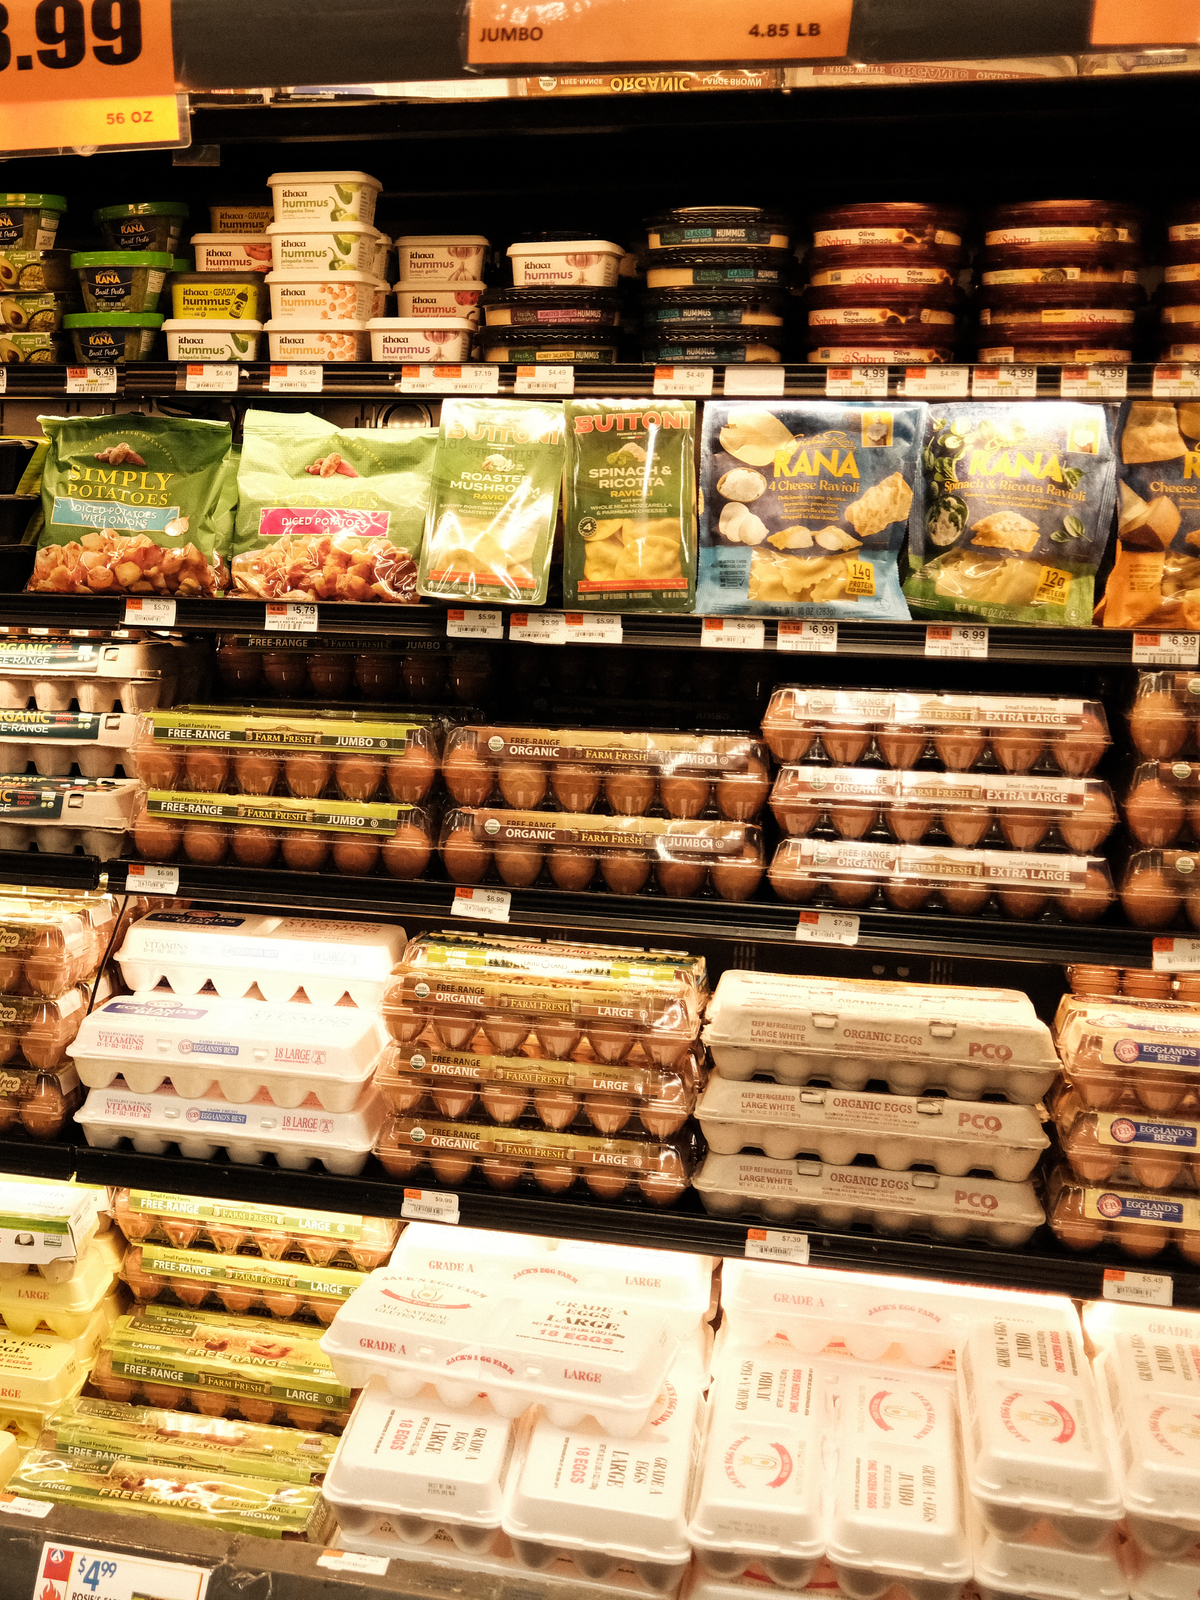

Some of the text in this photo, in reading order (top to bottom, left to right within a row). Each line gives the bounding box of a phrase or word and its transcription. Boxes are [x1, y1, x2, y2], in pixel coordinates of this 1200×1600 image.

[479, 24, 544, 43] JUMBO
[749, 23, 821, 40] 4.85 LB
[106, 111, 153, 125] 56 OZ
[282, 198, 328, 208] hummus
[685, 229, 745, 238] CLASSIC HUMMUS
[96, 274, 120, 284] RANA
[864, 273, 899, 284] Sabra
[183, 288, 208, 296] ithaca
[183, 297, 231, 306] hummus
[92, 368, 114, 376] $6.49
[859, 368, 885, 378] $4.99
[574, 410, 690, 433] BUITONI
[773, 449, 861, 479] RANA
[968, 451, 1064, 483] RANA
[68, 465, 174, 490] SIMPLY
[588, 467, 672, 478] SPINACH &
[599, 477, 665, 488] RICOTTA
[769, 480, 860, 494] 4 Cheese Ravioli
[67, 484, 169, 506] POTATOES
[610, 489, 653, 497] RAVIOLI
[944, 479, 984, 495] Spinach
[987, 480, 995, 490] &
[998, 481, 1042, 495] Ricotta
[1046, 485, 1087, 502] Ravioli
[75, 504, 157, 520] DICED POTATOES
[81, 513, 148, 527] WITH ONIONS
[281, 516, 367, 528] DICED POTATOES
[853, 563, 871, 581] 14g
[1045, 570, 1065, 588] 12g
[849, 580, 875, 590] PROTEIN
[293, 606, 315, 614] $5.79
[809, 624, 835, 635] $6.99
[251, 638, 308, 647] FREE-RANGE
[168, 729, 373, 746] FREE-RANGE FARM FRESH JUMBO
[509, 746, 560, 757] ORGANIC
[585, 750, 646, 760] FARM FRESH
[989, 869, 1070, 880] EXTRA LARGE
[436, 984, 484, 994] FREE-RANGE
[436, 993, 484, 1004] ORGANIC
[511, 999, 570, 1012] FARM FRESH
[598, 1007, 633, 1017] LARGE
[756, 1093, 795, 1101] REFRIGERATED
[106, 1103, 151, 1114] VITAMINS
[741, 1101, 795, 1112] LARGE WHITE
[833, 1098, 912, 1114] ORGANIC EGGS
[283, 1116, 317, 1129] 18 LARGE
[958, 1112, 1002, 1132] PCO
[1140, 1210, 1163, 1220] BEST
[782, 1235, 801, 1244] $7.39
[359, 1339, 406, 1354] GRADE A
[124, 1364, 184, 1381] FREE-RANGE
[564, 1369, 601, 1382] LARGE
[208, 1377, 262, 1392] FARM FRESH
[286, 1390, 319, 1402] LARGE
